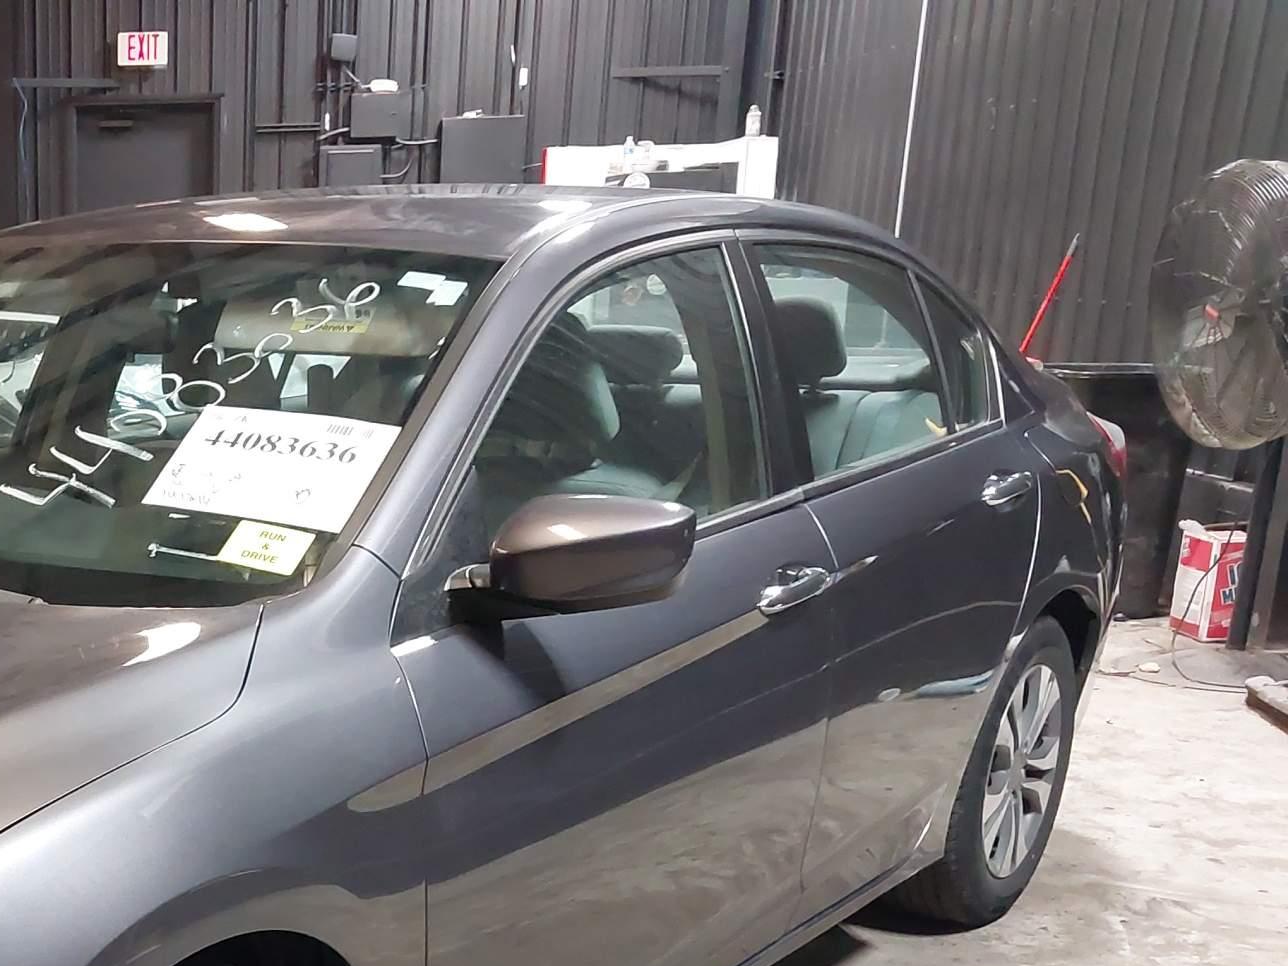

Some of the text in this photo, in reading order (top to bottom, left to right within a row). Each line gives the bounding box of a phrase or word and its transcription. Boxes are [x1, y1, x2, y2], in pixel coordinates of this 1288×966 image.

[127, 33, 160, 61] EXIT
[205, 429, 358, 464] 44083636
[259, 530, 287, 542] RUN
[262, 542, 269, 550] &
[241, 550, 279, 563] DRIVE
